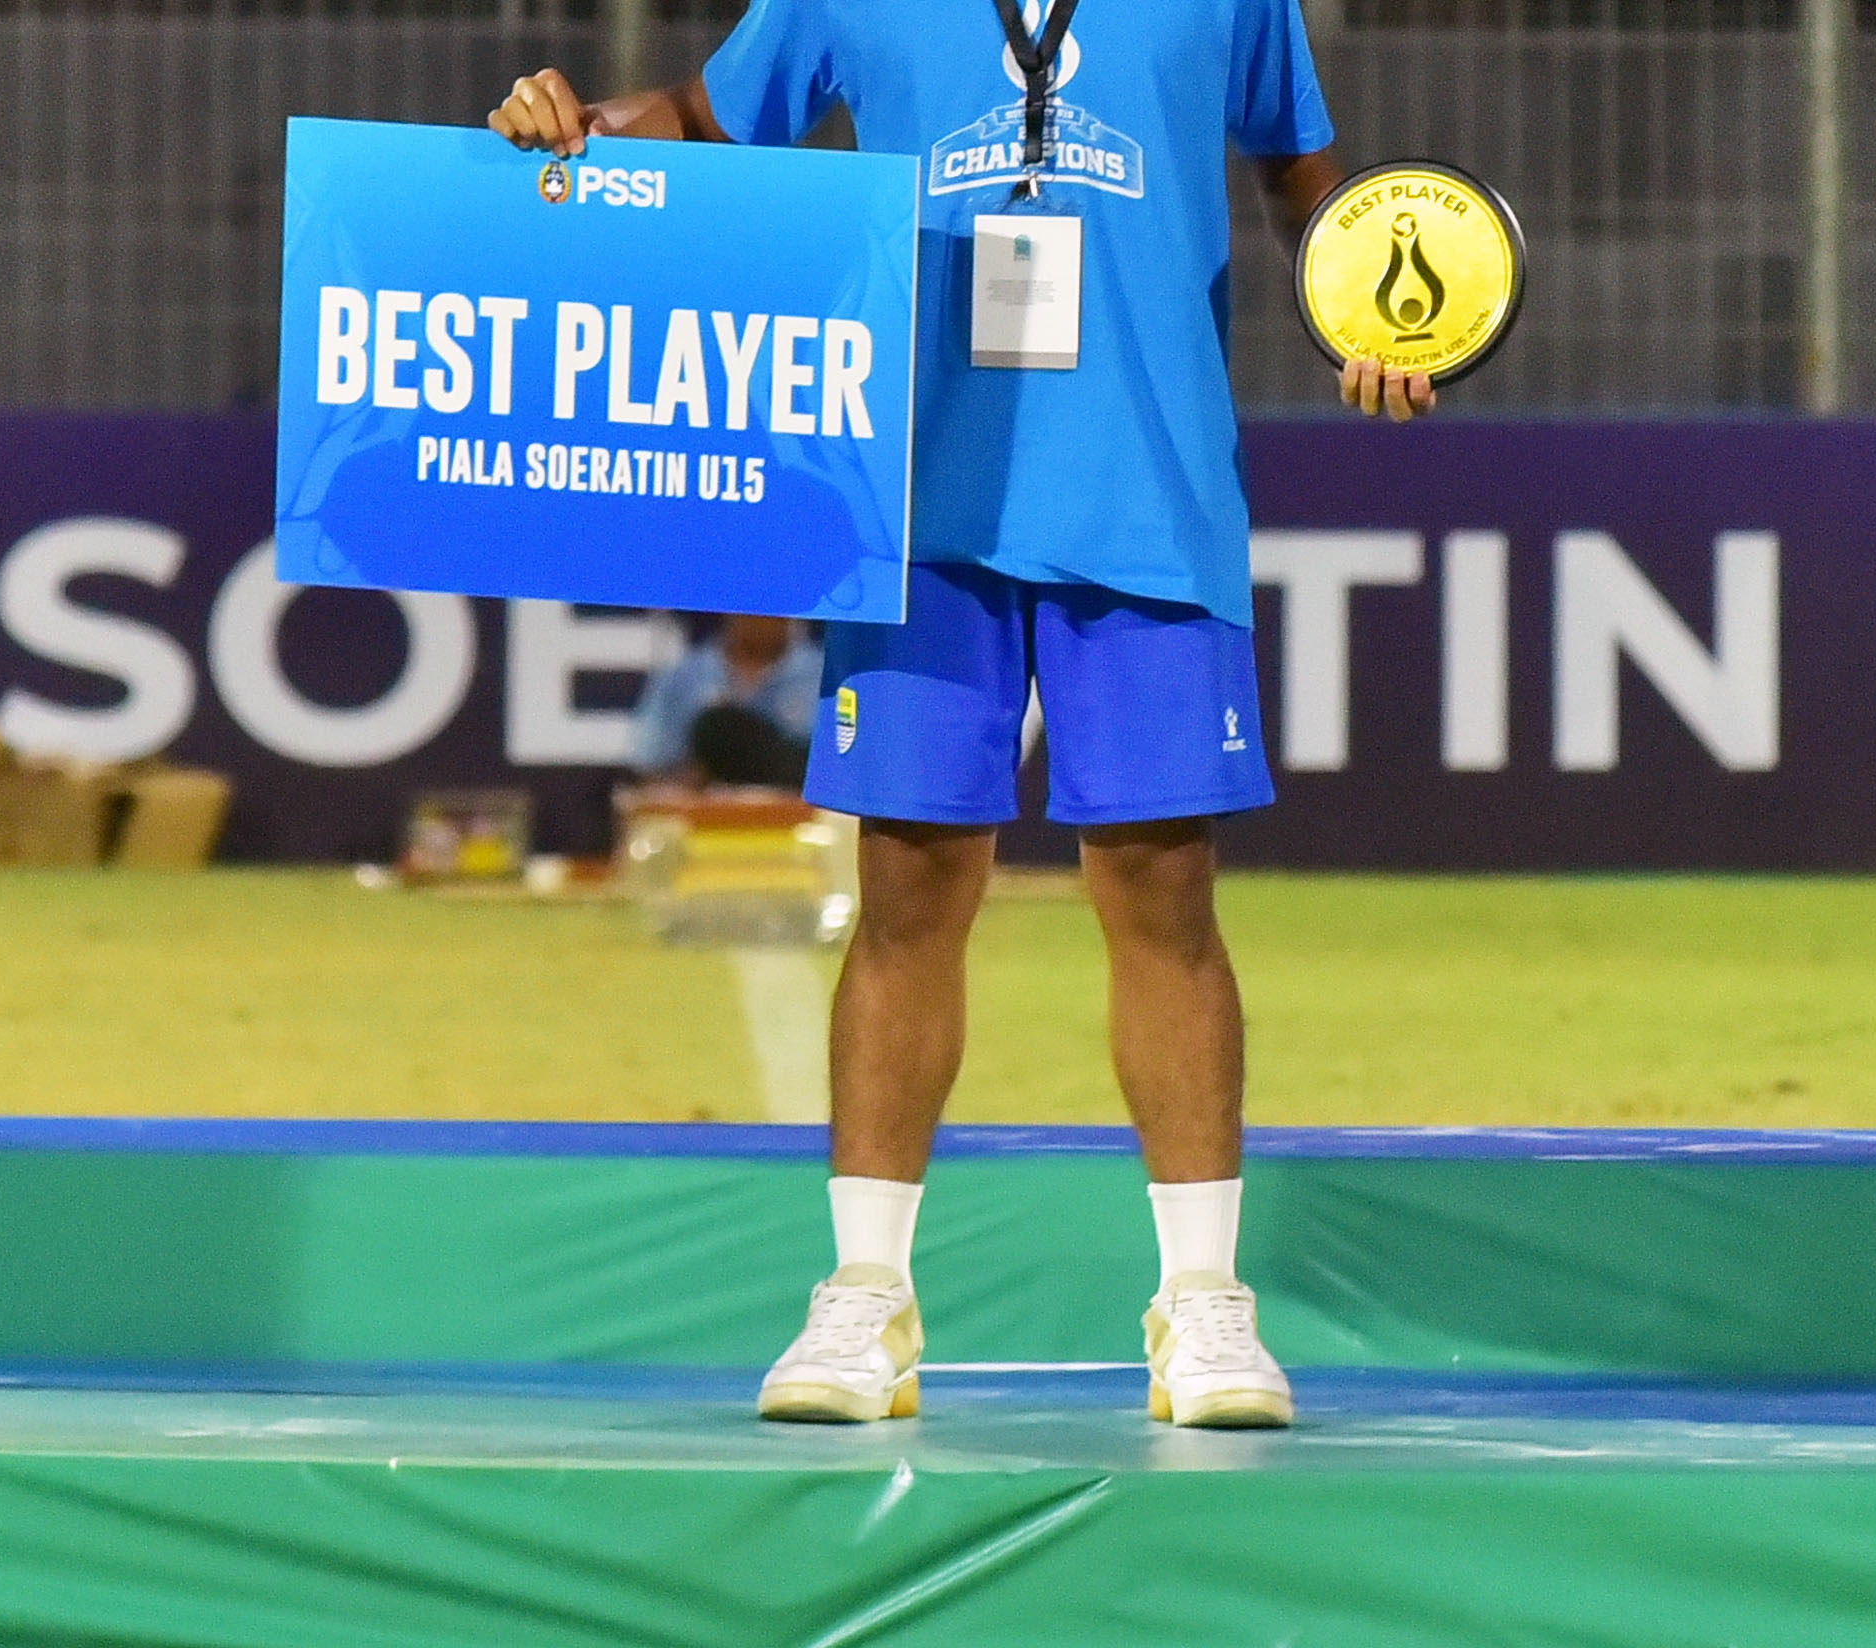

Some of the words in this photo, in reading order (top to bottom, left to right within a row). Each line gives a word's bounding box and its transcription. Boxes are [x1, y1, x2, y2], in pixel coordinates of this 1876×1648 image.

[577, 166, 666, 209] PSSI
[1338, 190, 1385, 230] BEST
[1391, 184, 1469, 217] PLAYER
[317, 285, 528, 415] BEST
[553, 301, 874, 439] PLAYER
[417, 436, 514, 487] PIALA
[525, 444, 687, 499] SOERATIN
[698, 455, 765, 503] U15
